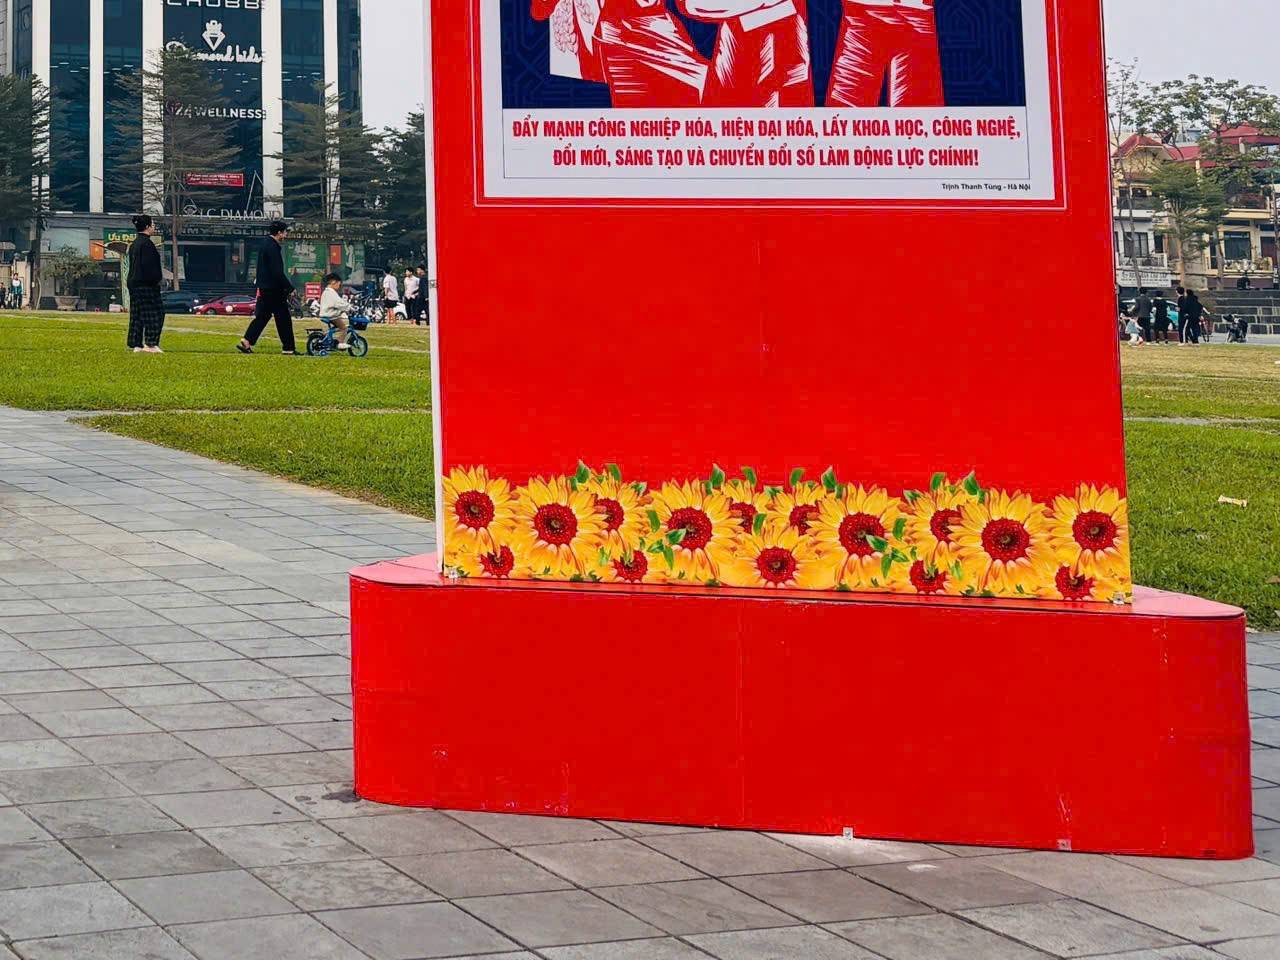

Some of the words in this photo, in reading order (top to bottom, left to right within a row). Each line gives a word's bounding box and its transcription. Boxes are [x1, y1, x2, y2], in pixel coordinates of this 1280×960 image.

[194, 106, 263, 119] WELLNESS
[512, 114, 540, 138] ĐẨY
[543, 119, 584, 141] MẠNH
[588, 116, 626, 137] CÔNG
[630, 117, 681, 141] NGHIỆP
[685, 117, 718, 139] HÓA,
[721, 116, 754, 140] HIỆN
[757, 118, 782, 140] ĐẠI
[786, 116, 819, 139] HÓA,
[822, 114, 848, 138] LẤY
[852, 118, 891, 137] KHOA
[894, 119, 928, 140] HỌC,
[932, 115, 972, 137] CÔNG
[976, 115, 1021, 140] NGHỆ,
[553, 142, 576, 166] ĐỔI
[580, 144, 611, 168] MỚI,
[615, 145, 654, 166] SÁNG
[658, 148, 683, 170] TẠO
[686, 145, 706, 166] VÀ
[709, 142, 765, 166] CHUYỂN
[768, 142, 792, 166] ĐỔI
[796, 142, 816, 166] SỐ
[820, 144, 850, 167] LÀM
[853, 145, 894, 169] ĐỘNG
[897, 147, 925, 169] LỰC
[927, 144, 980, 167] CHÍNH!
[941, 182, 960, 192] Trịnh
[960, 182, 983, 191] Thanh
[983, 182, 1003, 192] Tùng
[1007, 182, 1018, 191] Hà
[1018, 182, 1031, 192] Nội
